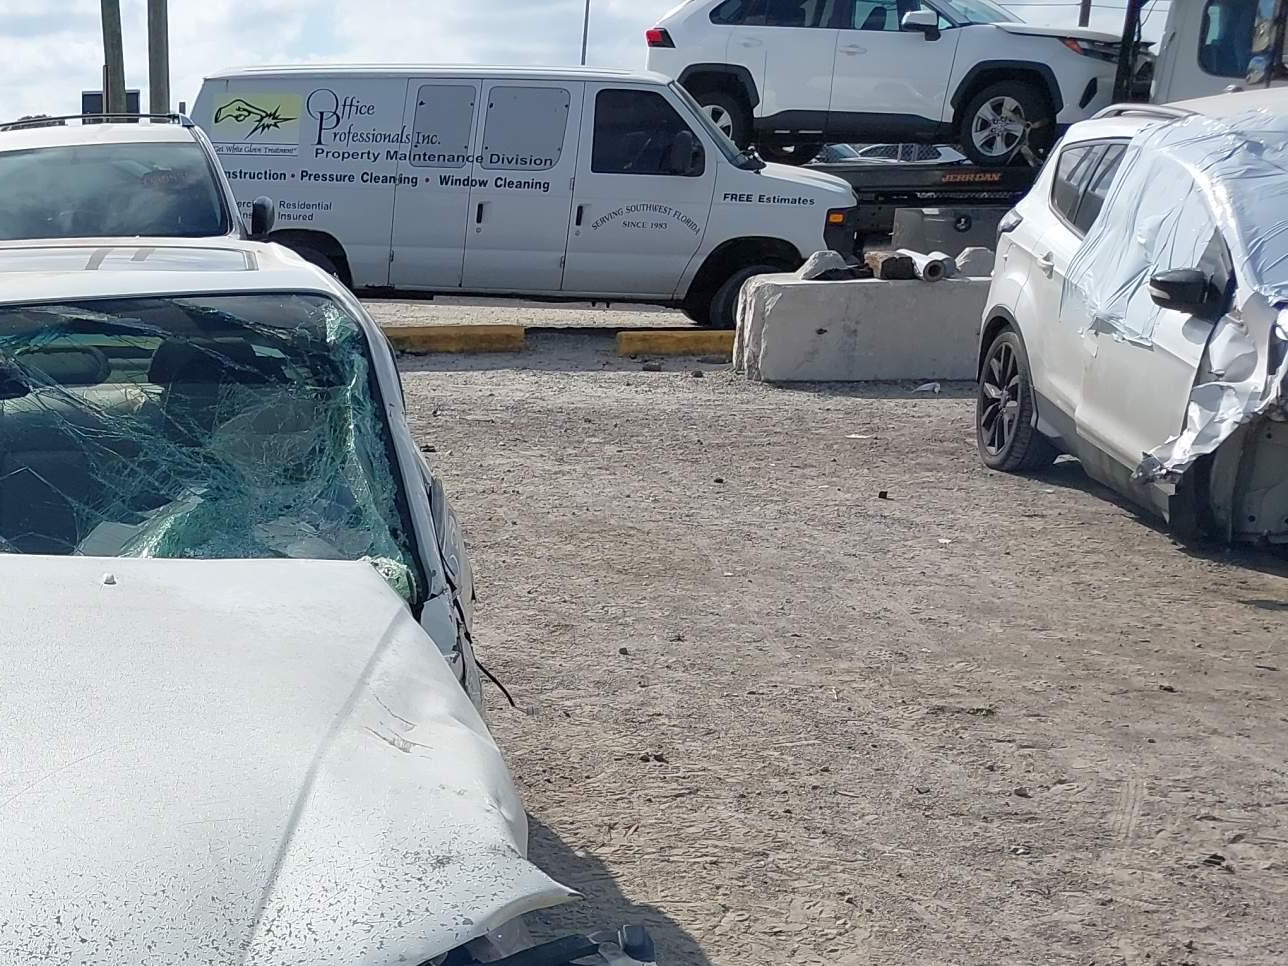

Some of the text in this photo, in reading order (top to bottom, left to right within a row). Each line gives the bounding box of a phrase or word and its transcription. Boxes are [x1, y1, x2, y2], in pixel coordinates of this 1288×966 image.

[307, 88, 375, 120] Office
[312, 111, 441, 147] Professionals Inc.
[314, 148, 553, 166] Property Maintenance Division
[224, 168, 550, 192] nstruction Pressure Cleaning Window Cleaning
[279, 200, 332, 211] Residential
[723, 192, 816, 206] FREE Estimates
[278, 212, 314, 221] Insured
[592, 203, 701, 236] SERVING SOUTHWEST FLORIDA
[622, 220, 647, 229] SINCE
